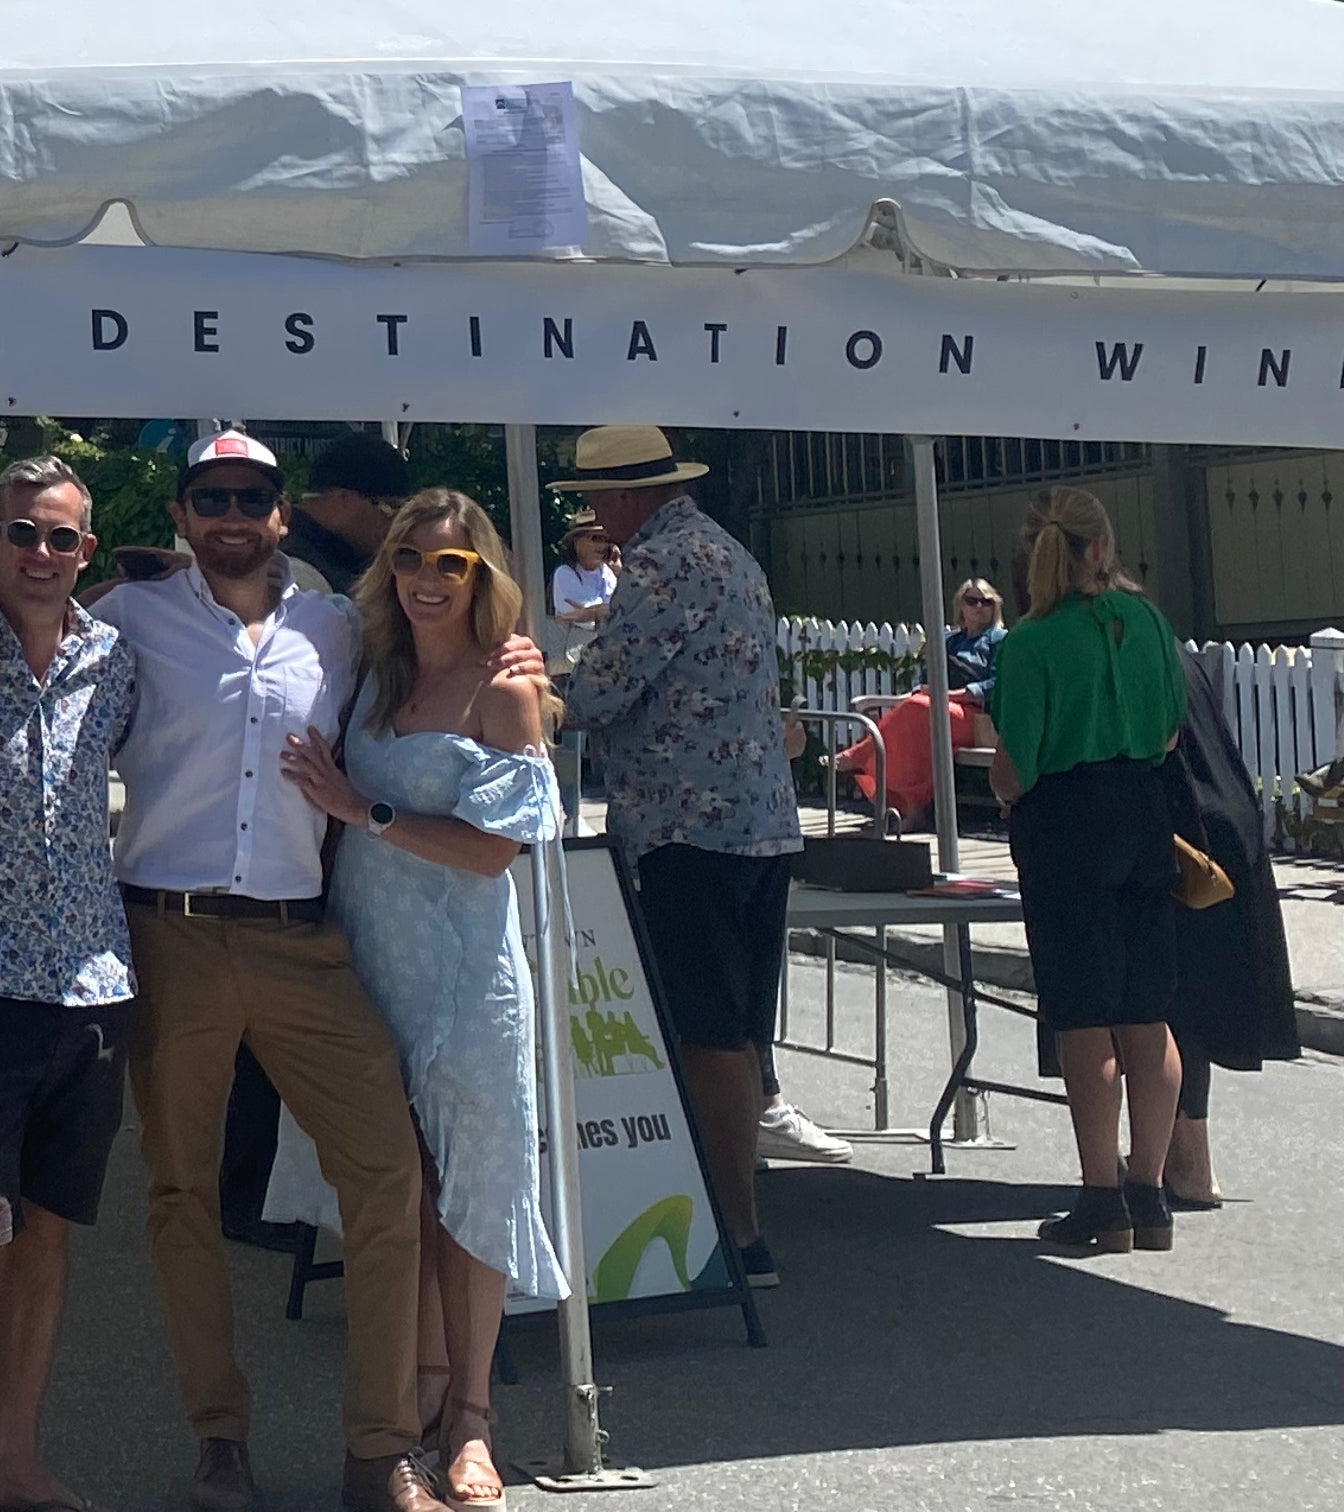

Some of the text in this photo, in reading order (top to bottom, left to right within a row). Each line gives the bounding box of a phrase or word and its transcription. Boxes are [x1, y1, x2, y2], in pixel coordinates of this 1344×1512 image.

[91, 308, 974, 374] DESTINATION
[1095, 341, 1344, 389] WIN
[620, 1113, 672, 1149] you
